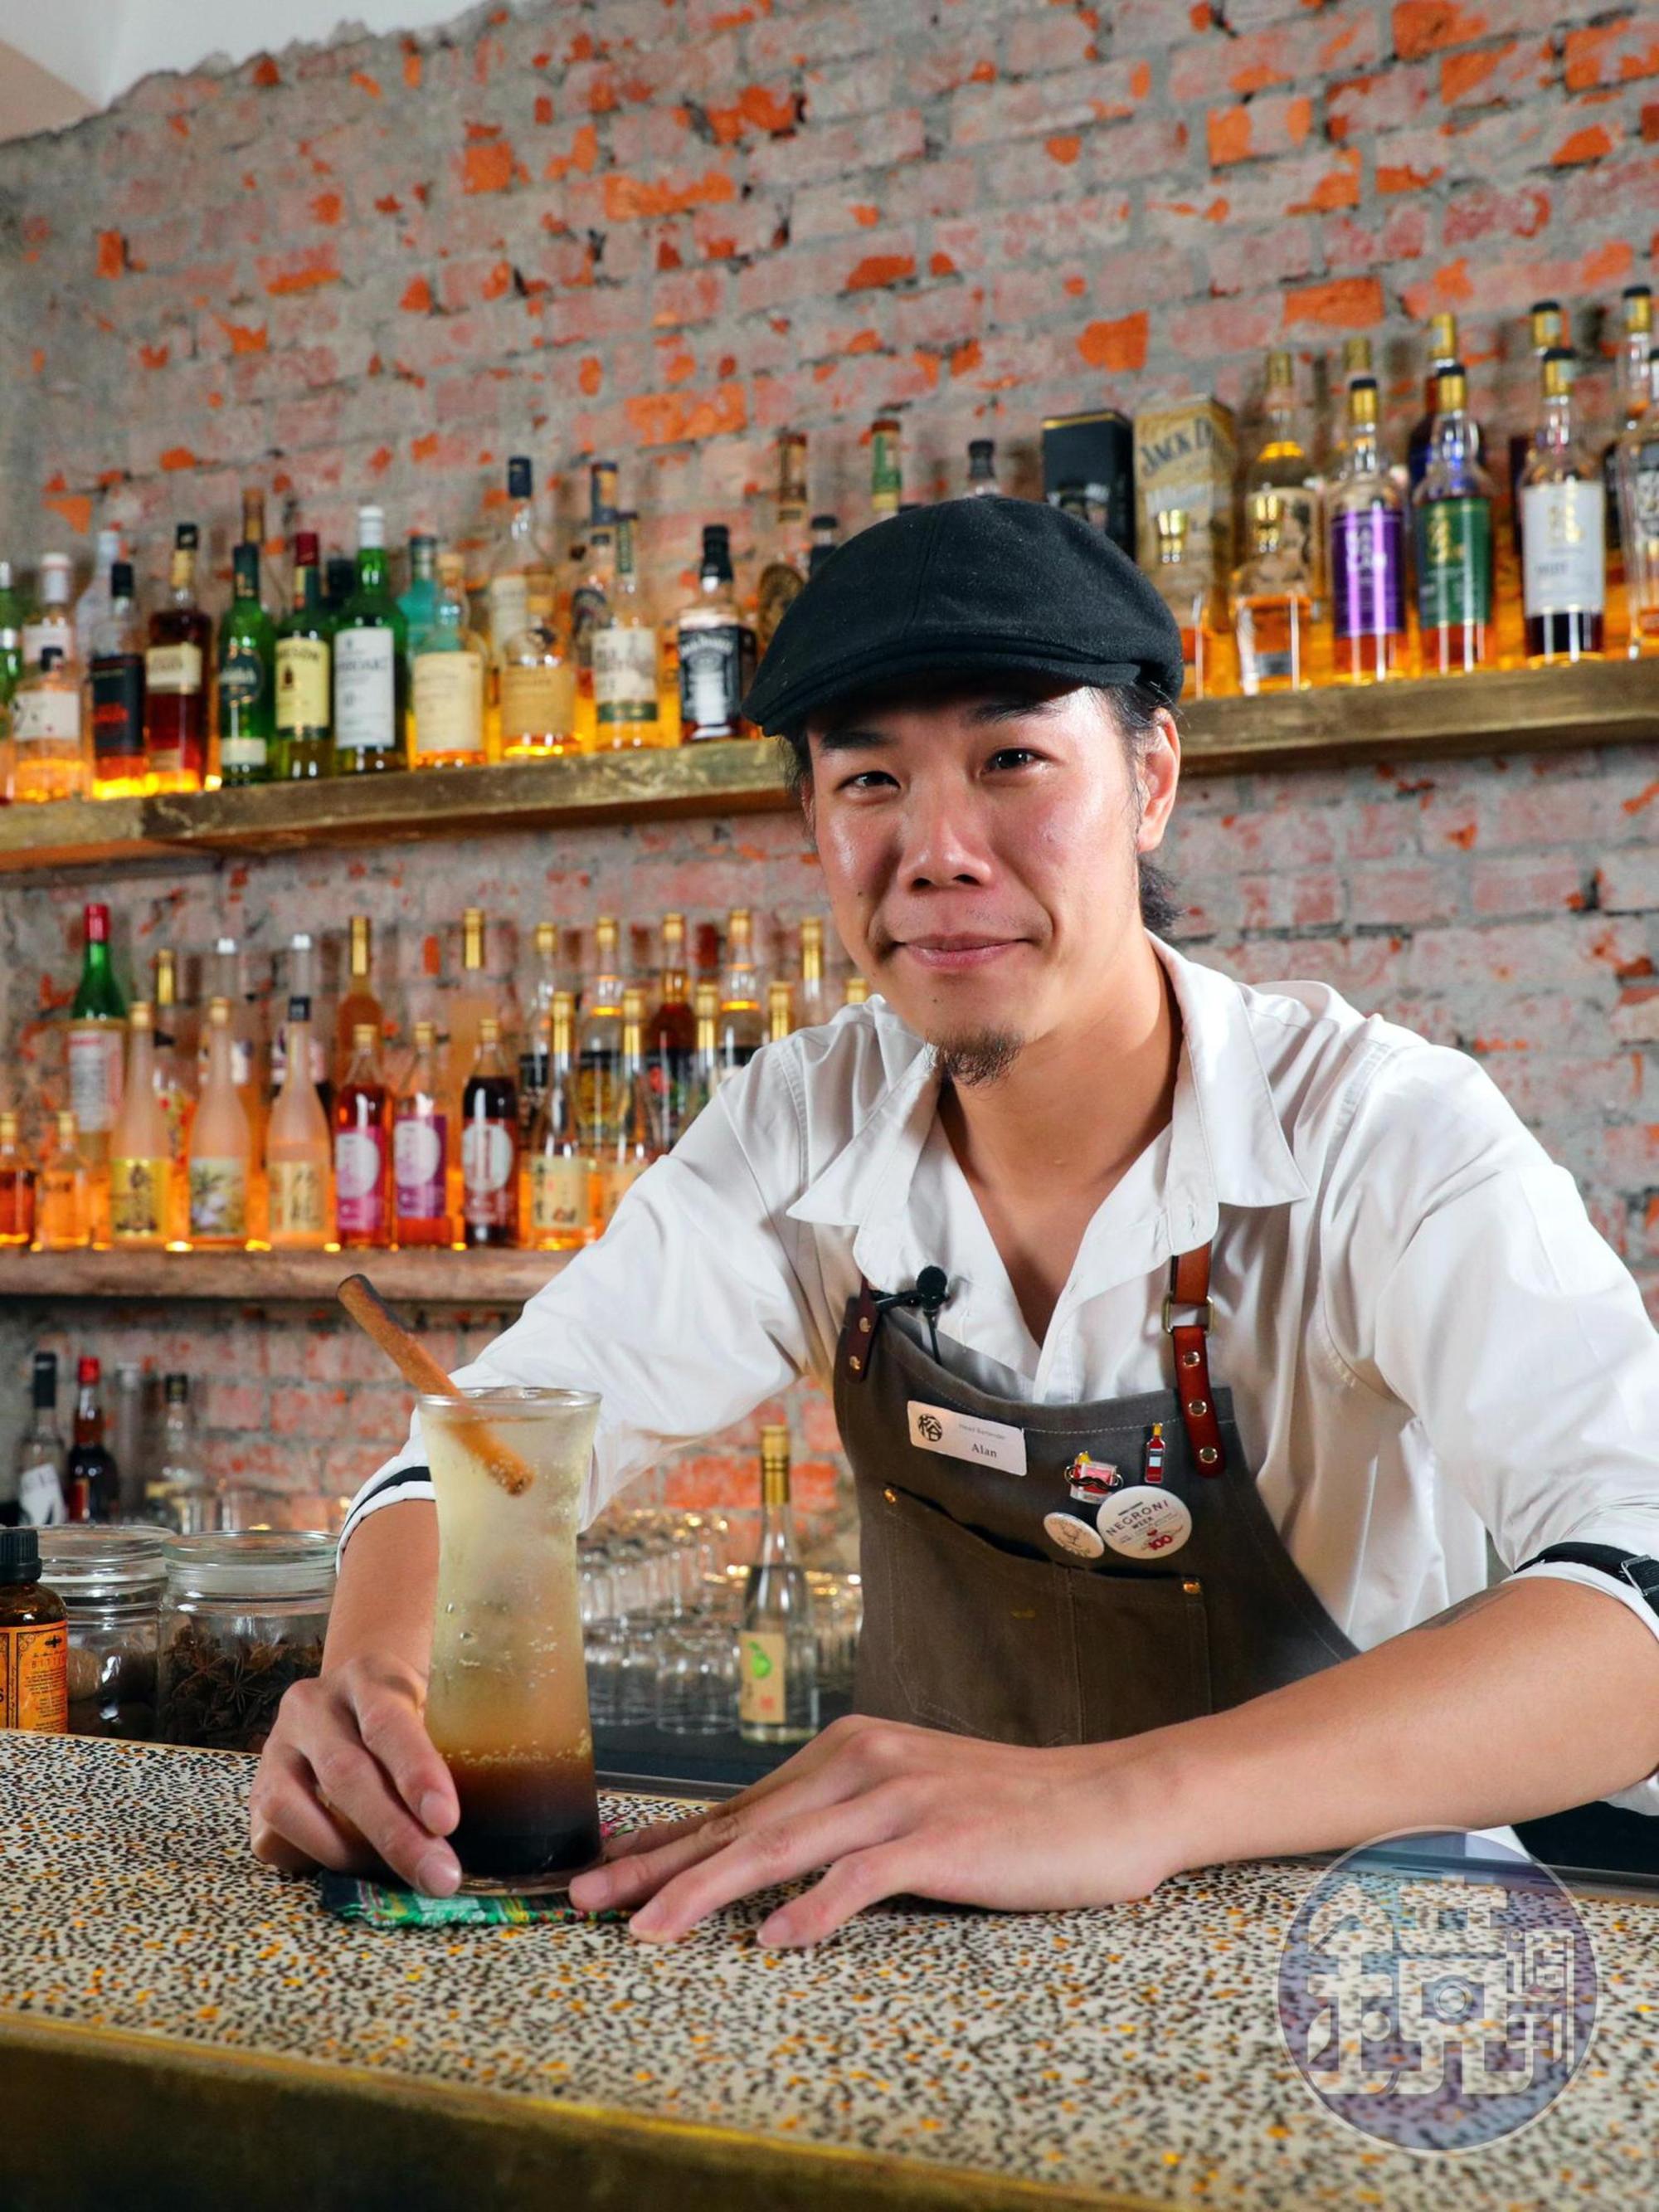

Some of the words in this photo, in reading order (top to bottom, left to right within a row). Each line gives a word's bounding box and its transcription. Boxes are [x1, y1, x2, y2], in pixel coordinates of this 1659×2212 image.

[971, 1443, 998, 1459] Alan
[1106, 1499, 1170, 1537] NEGRONI
[1131, 1516, 1154, 1528] WEEK
[1148, 1535, 1173, 1551] 100
